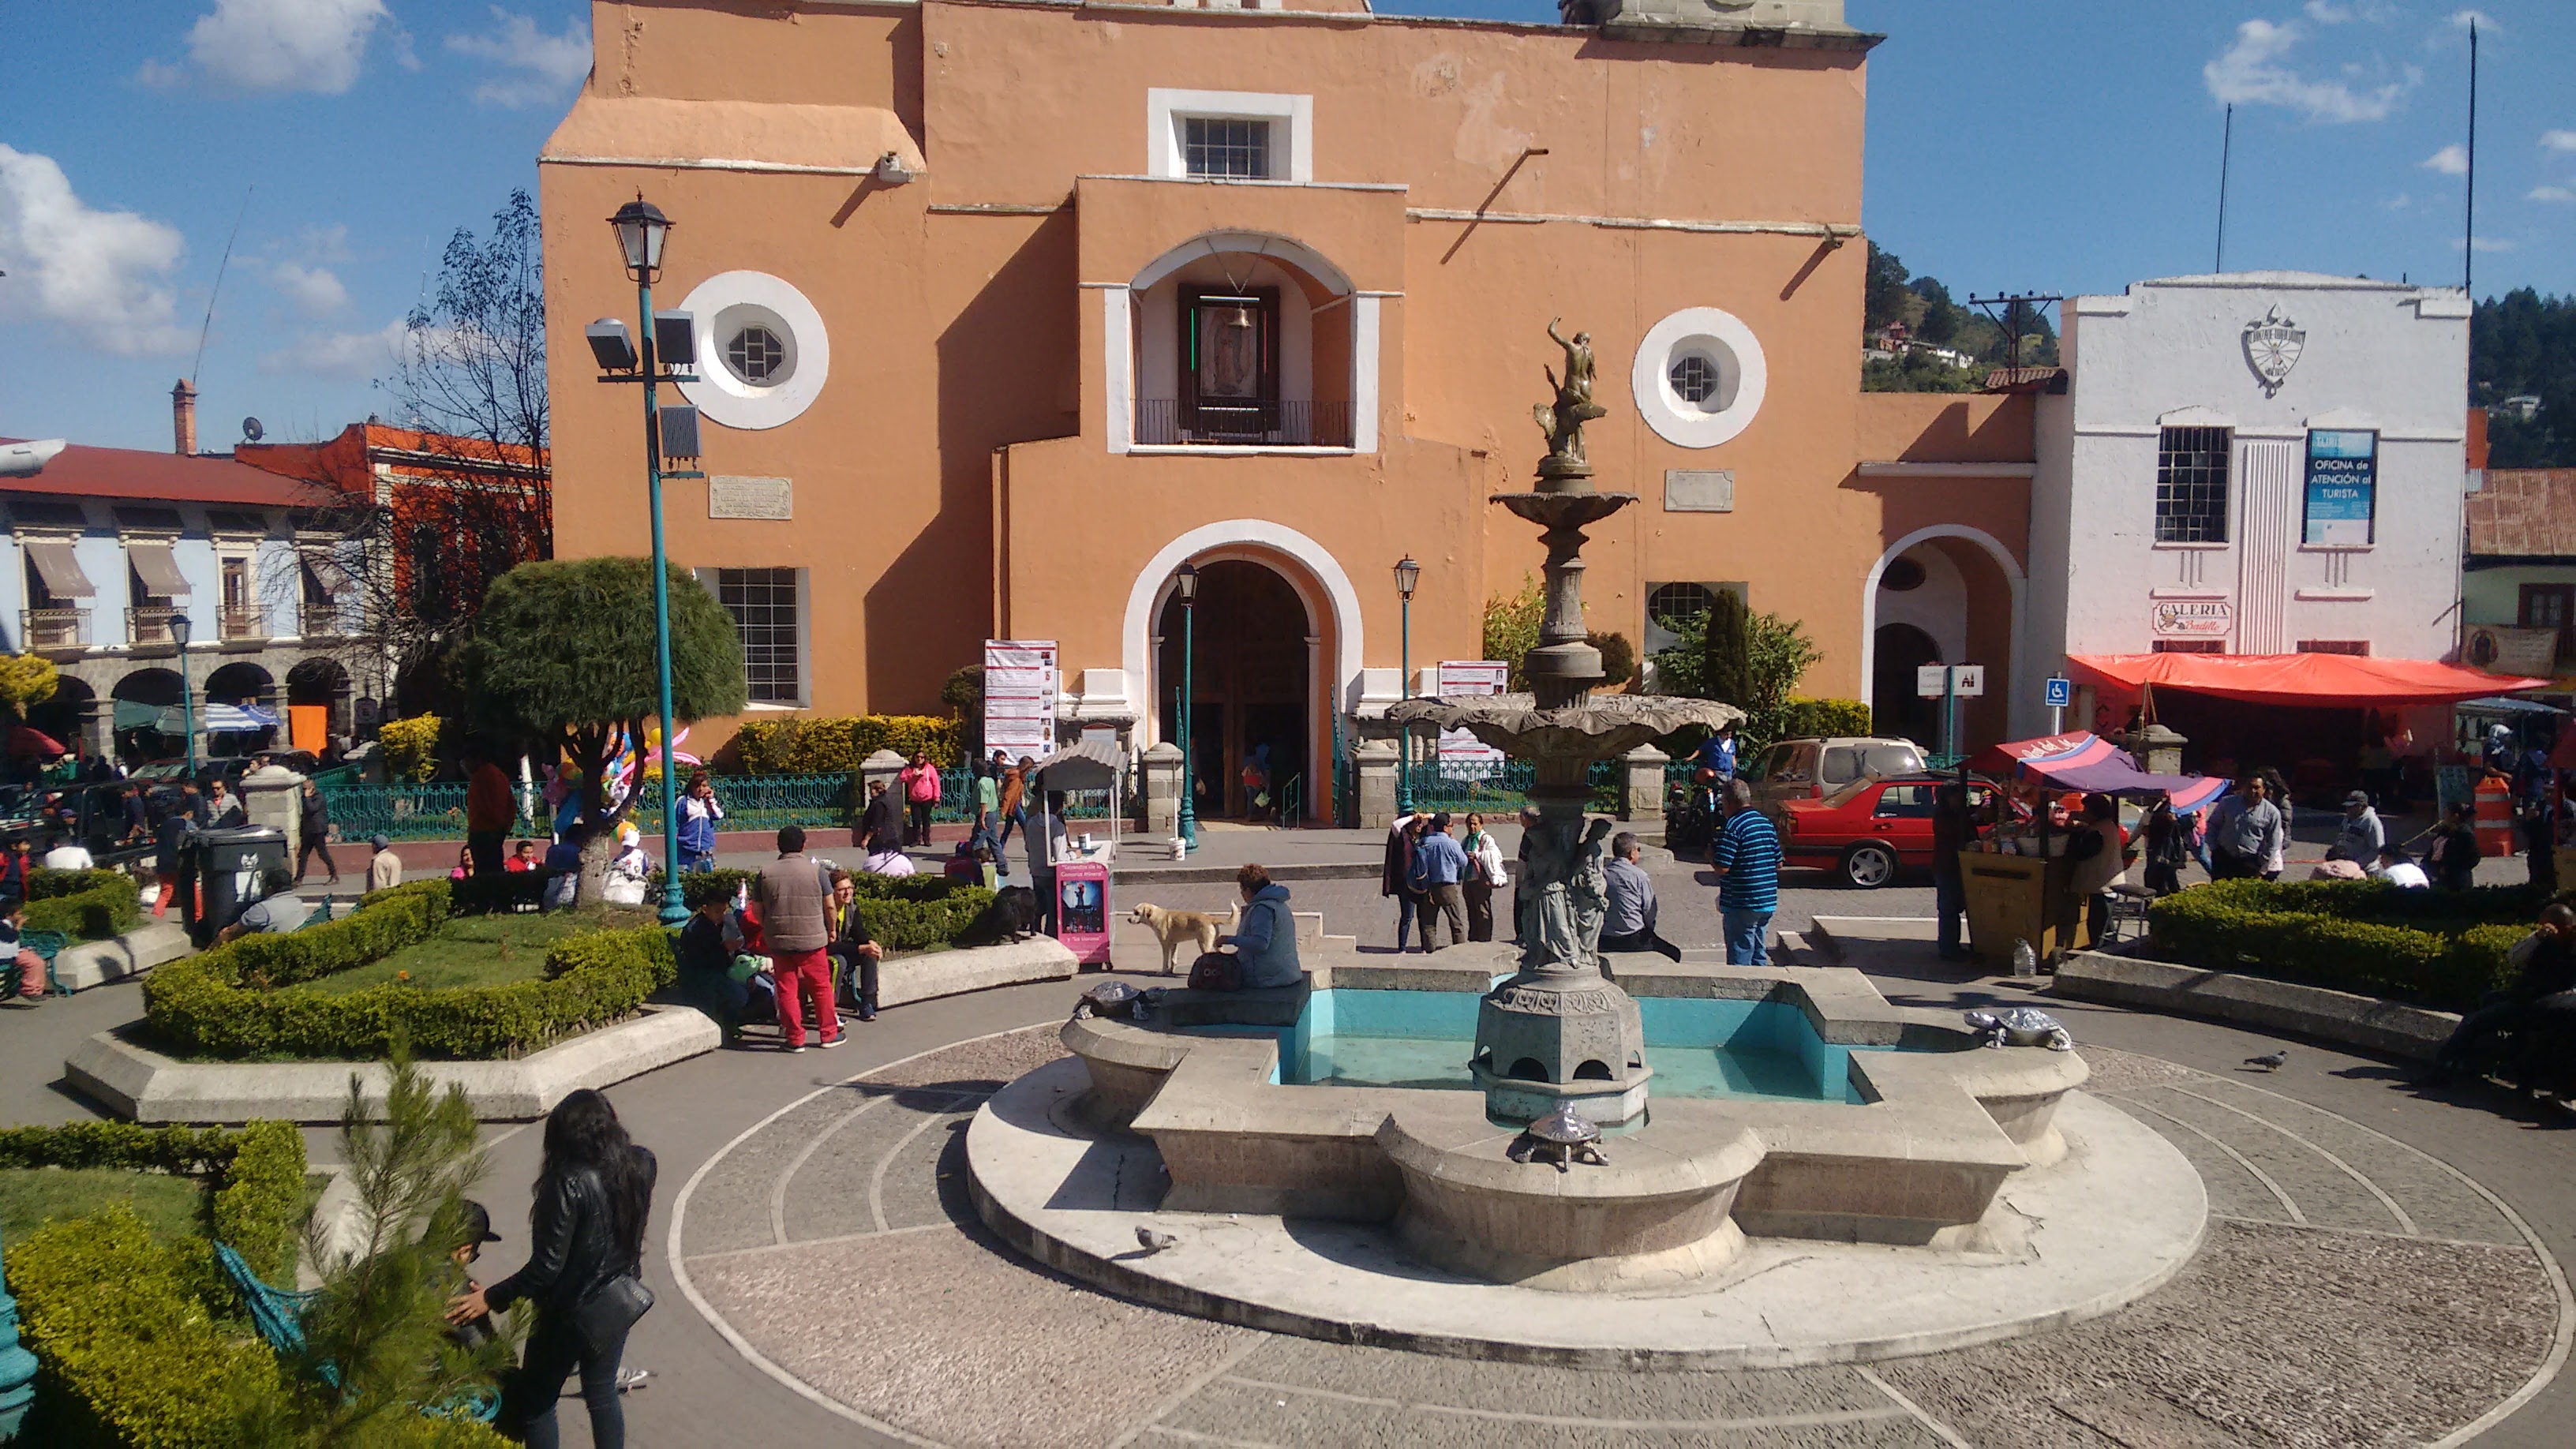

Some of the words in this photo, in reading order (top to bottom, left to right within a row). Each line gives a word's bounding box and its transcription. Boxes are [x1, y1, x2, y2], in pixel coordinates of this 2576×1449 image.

[2315, 460, 2353, 470] OFICINA
[2357, 460, 2368, 470] de
[2311, 472, 2360, 485] ATENCIÓN
[2362, 474, 2371, 485] al
[2322, 489, 2359, 499] TURISTA
[2159, 604, 2226, 616] GALERIA
